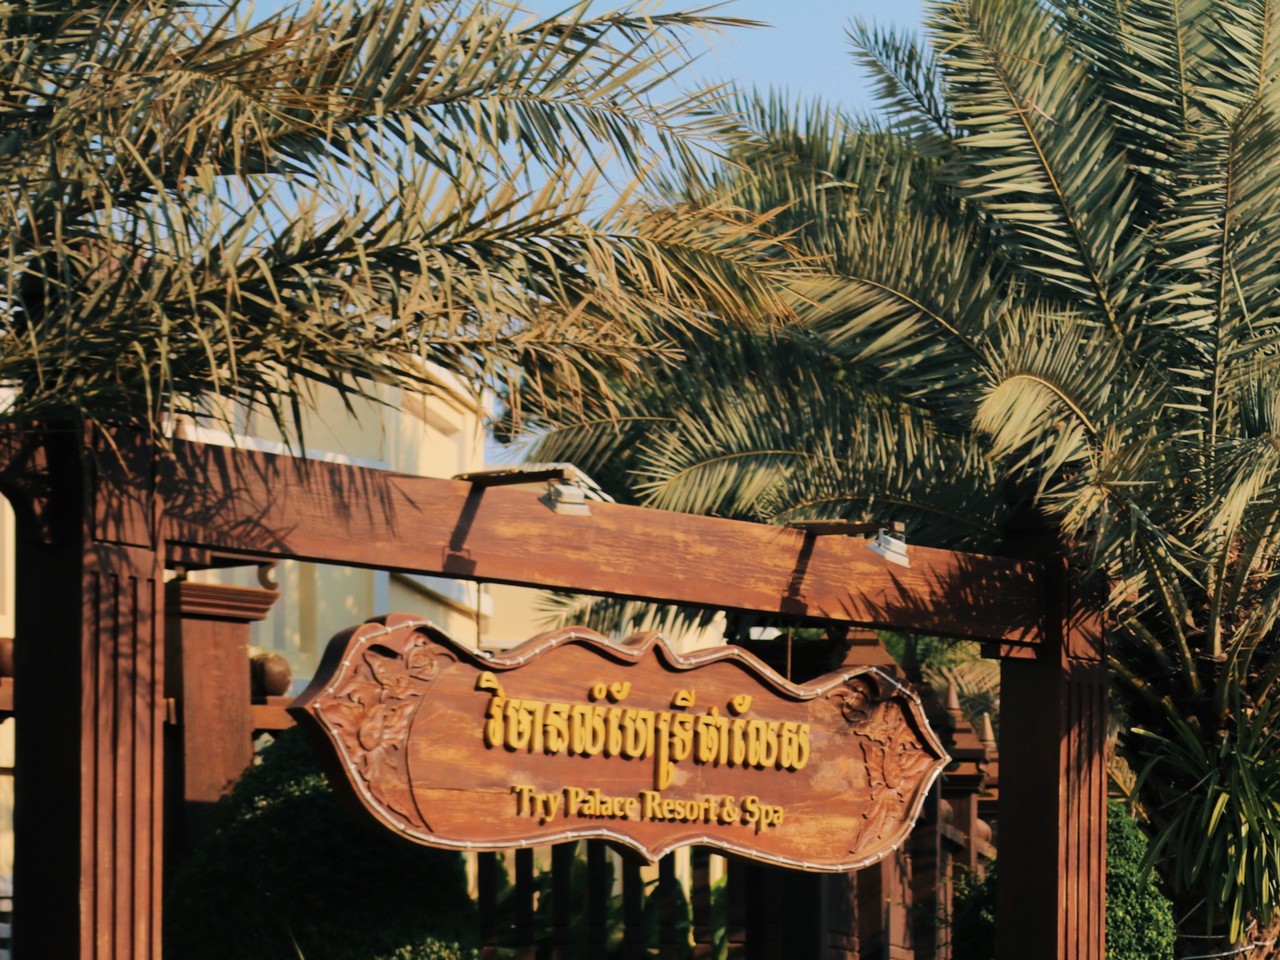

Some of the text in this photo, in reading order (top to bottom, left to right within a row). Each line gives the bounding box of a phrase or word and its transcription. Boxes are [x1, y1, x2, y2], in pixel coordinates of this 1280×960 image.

[513, 785, 784, 832] Try Palace Resort & Spa
